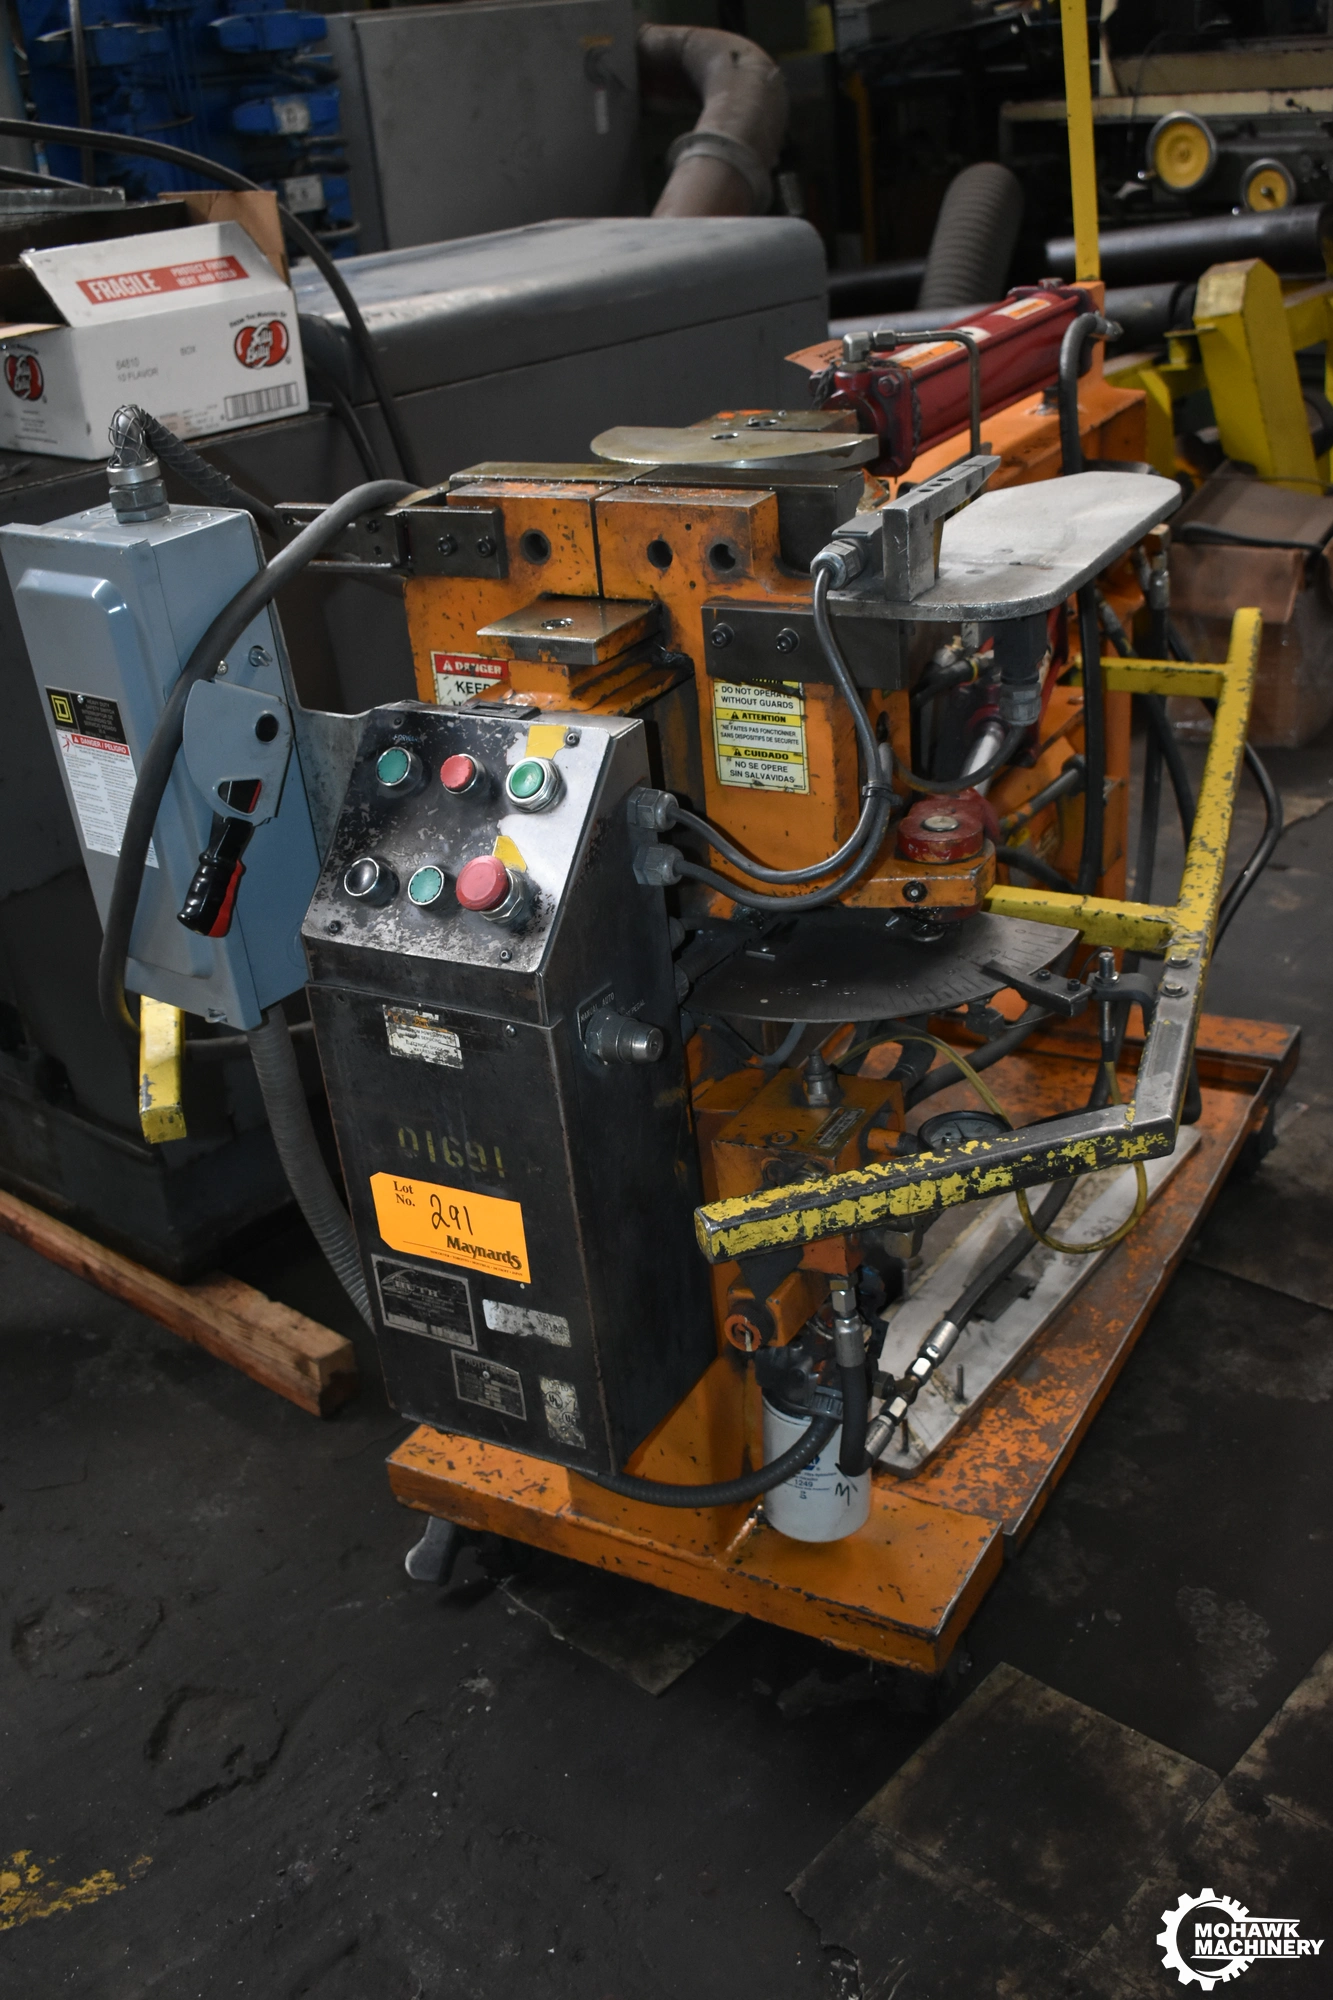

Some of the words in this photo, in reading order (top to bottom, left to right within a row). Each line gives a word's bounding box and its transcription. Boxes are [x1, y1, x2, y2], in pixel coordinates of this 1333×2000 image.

[87, 272, 161, 301] FRAGILE
[735, 687, 752, 695] NOT
[721, 696, 757, 705] WITHOUT
[759, 700, 794, 709] GUARDS
[741, 712, 786, 723] ATTENTION
[730, 725, 748, 733] FAITES
[80, 738, 102, 748] DANGER
[104, 743, 127, 753] PELIGRO
[744, 749, 789, 760] CUIDADO
[760, 763, 788, 772] OPERE
[730, 769, 743, 777] SIN
[744, 771, 795, 783] SALVAVIDAS
[602, 992, 615, 1006] AUTO
[393, 1180, 414, 1195] Lot
[395, 1193, 416, 1207] No.
[430, 1194, 474, 1236] 291
[446, 1235, 522, 1271] Maynards
[795, 1479, 813, 1488] 1249
